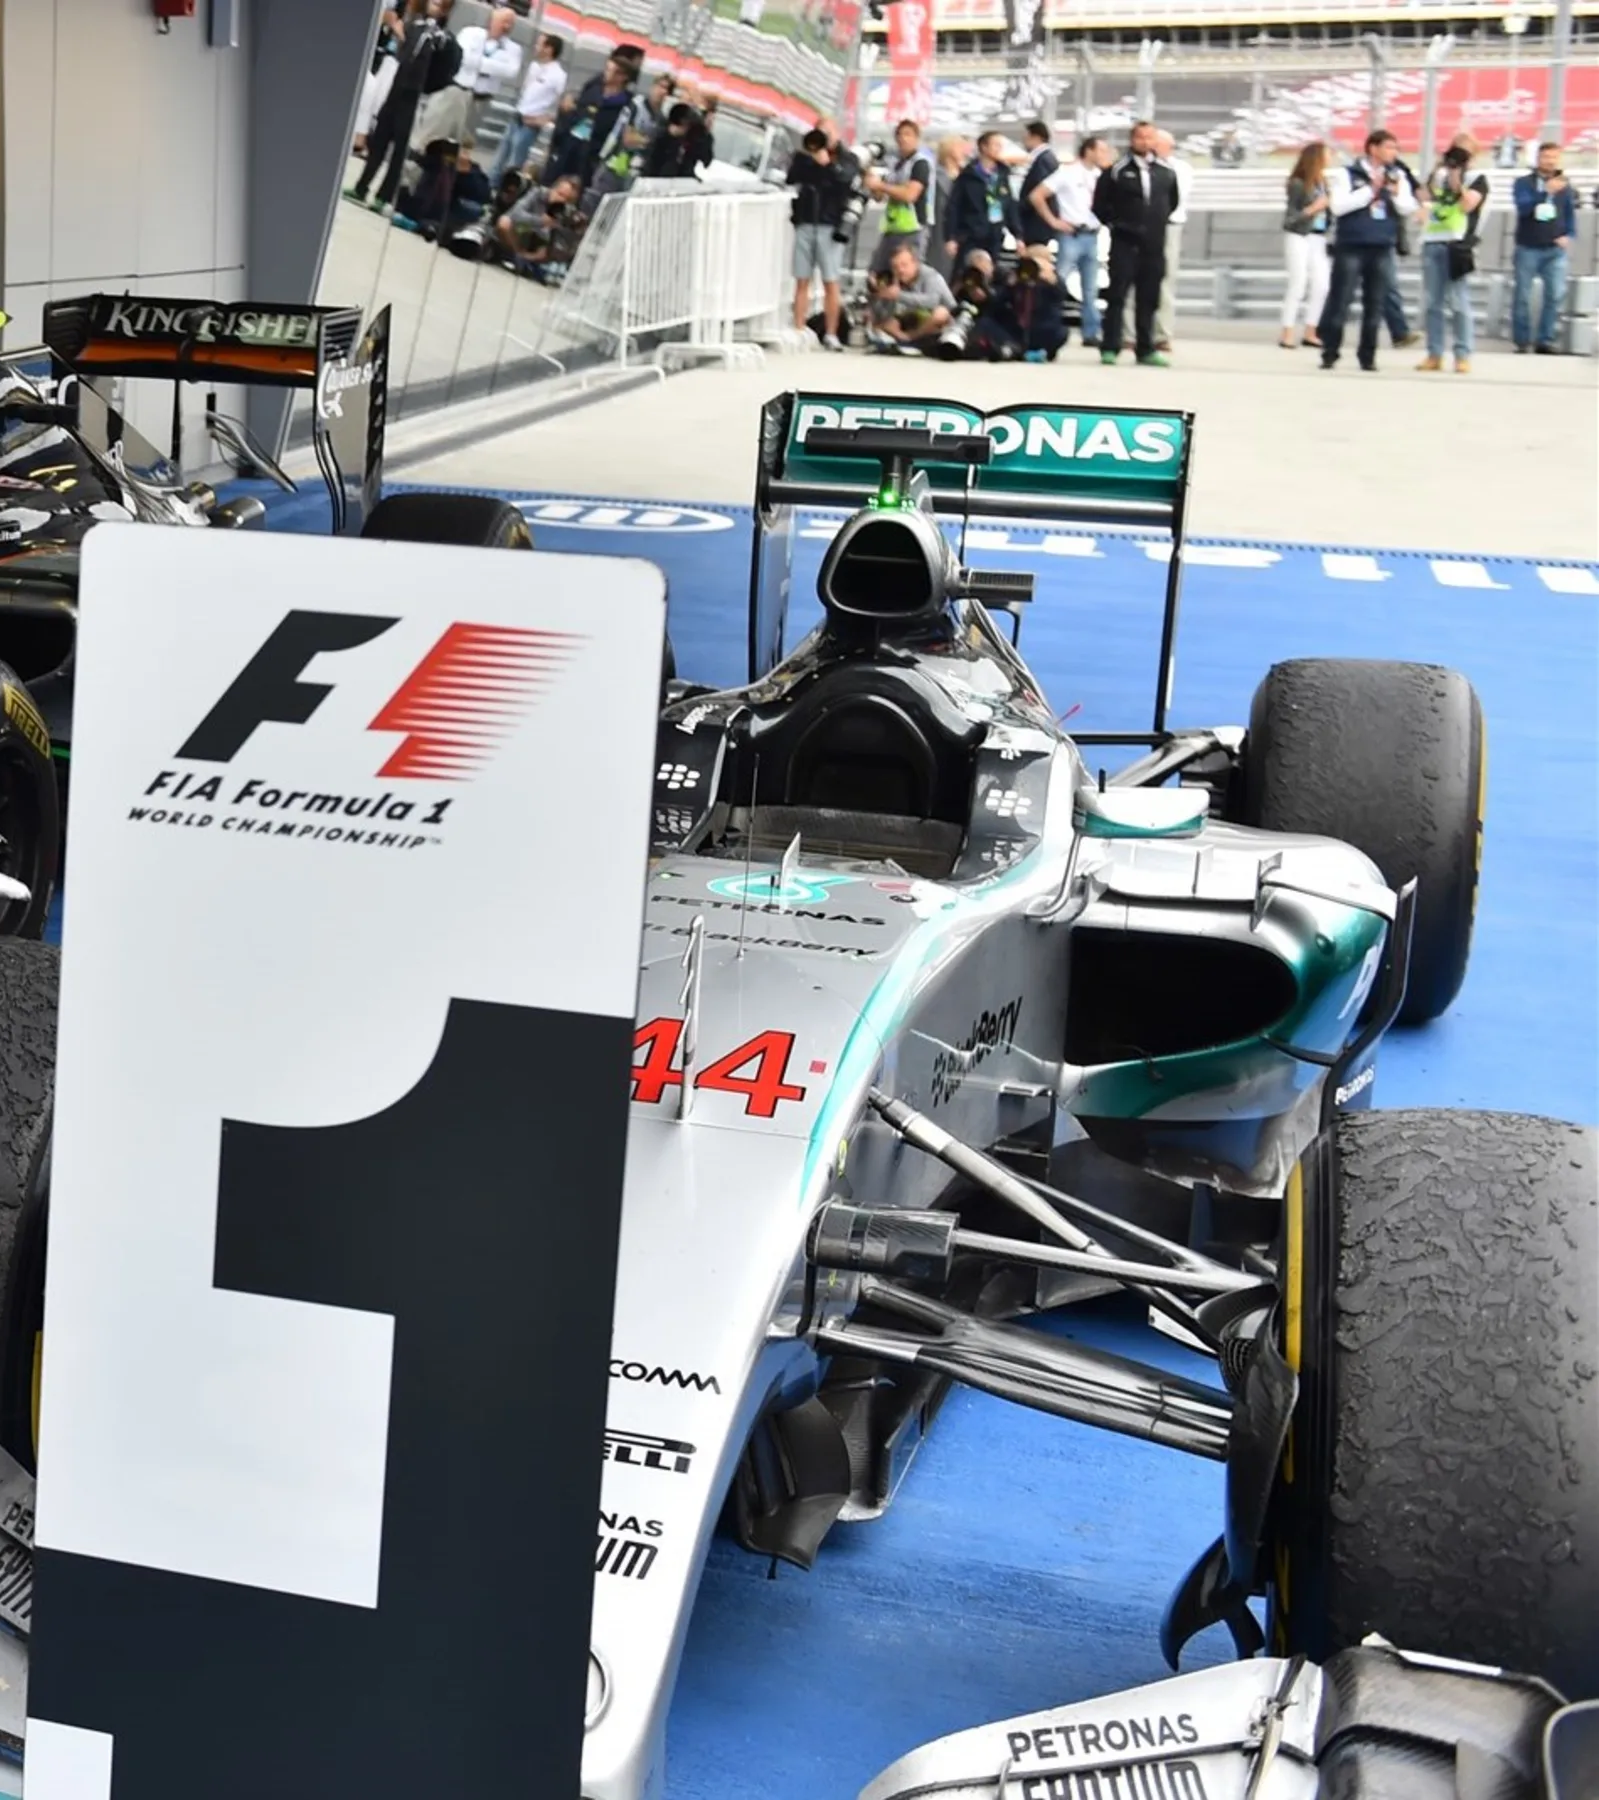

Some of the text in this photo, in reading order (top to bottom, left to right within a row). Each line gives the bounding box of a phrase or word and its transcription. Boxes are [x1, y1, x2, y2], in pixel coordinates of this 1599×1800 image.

[127, 806, 214, 828] WORLD
[143, 770, 453, 825] FIA Formula 1
[651, 894, 886, 926] PETRONAS
[671, 927, 879, 956] BackBerry
[631, 1016, 807, 1118] 44
[1006, 1713, 1200, 1762] PETRONAS
